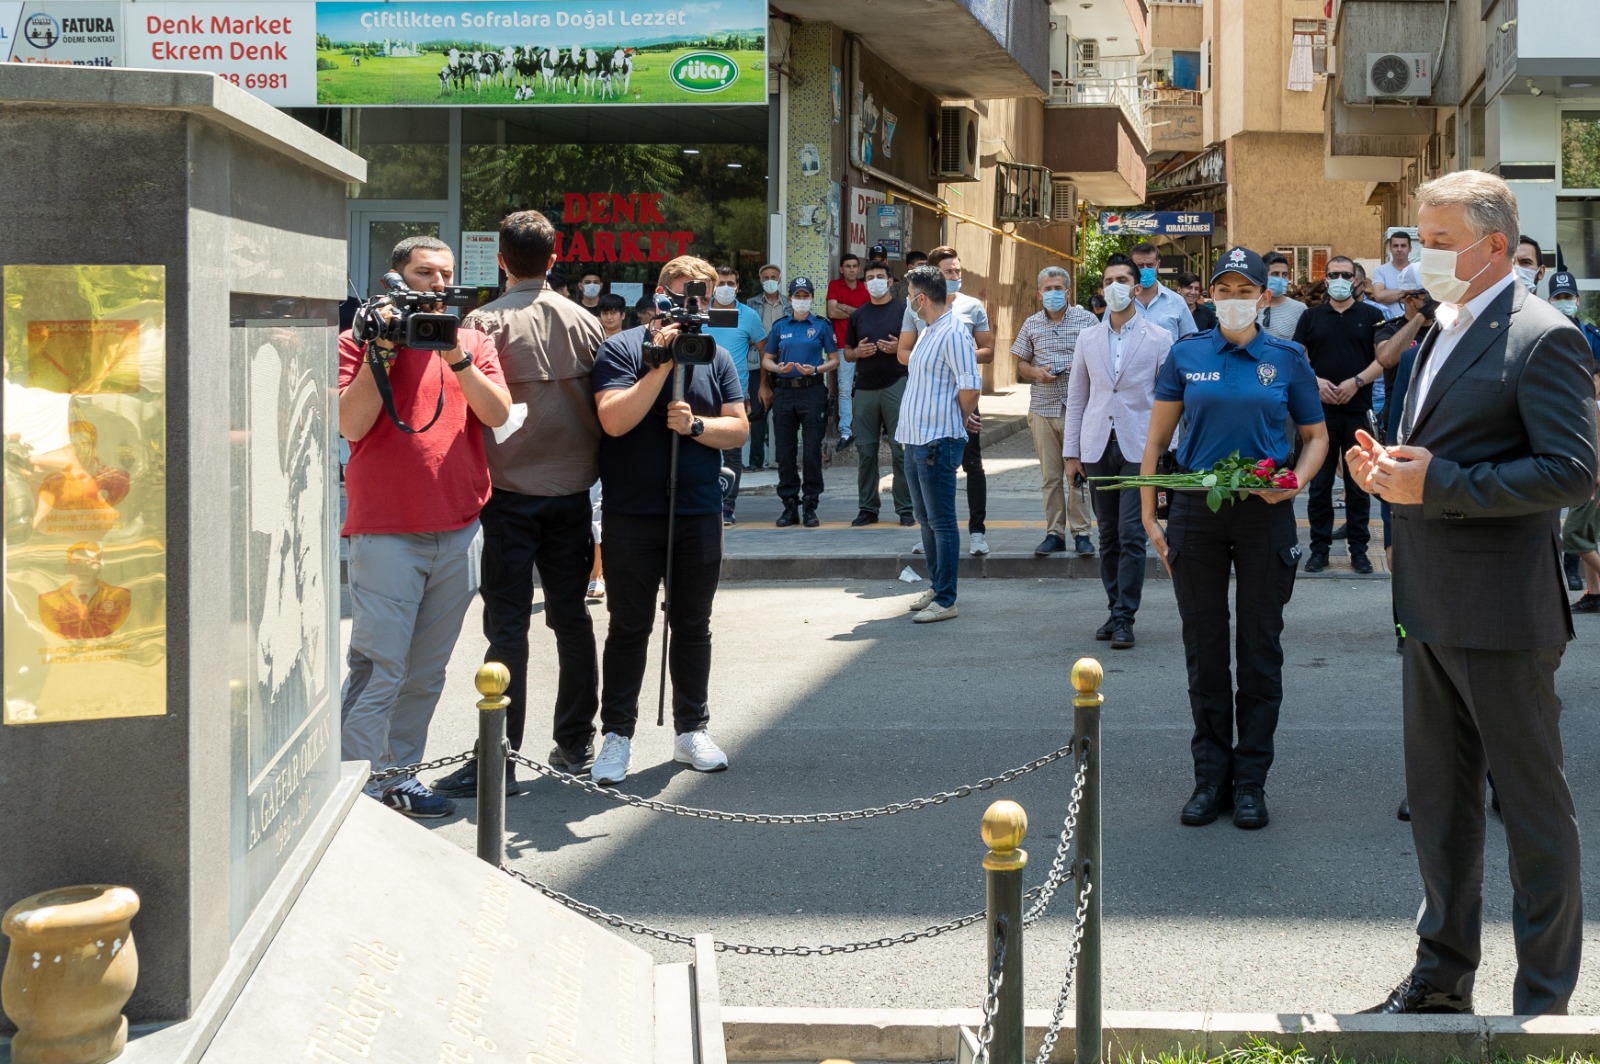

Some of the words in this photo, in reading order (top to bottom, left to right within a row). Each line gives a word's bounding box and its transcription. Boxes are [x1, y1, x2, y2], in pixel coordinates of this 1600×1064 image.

[62, 18, 115, 33] FATURA
[146, 15, 204, 35] Denk
[210, 15, 292, 35] Market
[360, 11, 456, 32] Çiftlikten
[461, 11, 550, 28] Sofralara
[556, 9, 616, 30] Doğal
[620, 10, 686, 26] Lezzet
[62, 35, 86, 43] ÖDEME
[152, 41, 223, 60] Ekrem
[230, 41, 288, 60] Denk
[245, 73, 287, 89] 6981
[678, 60, 730, 85] sütaş
[562, 192, 665, 224] DENK
[858, 193, 885, 216] DE
[1120, 219, 1159, 228] PEPSI
[261, 754, 300, 833] GAFFAR
[301, 712, 331, 778] OKKAN
